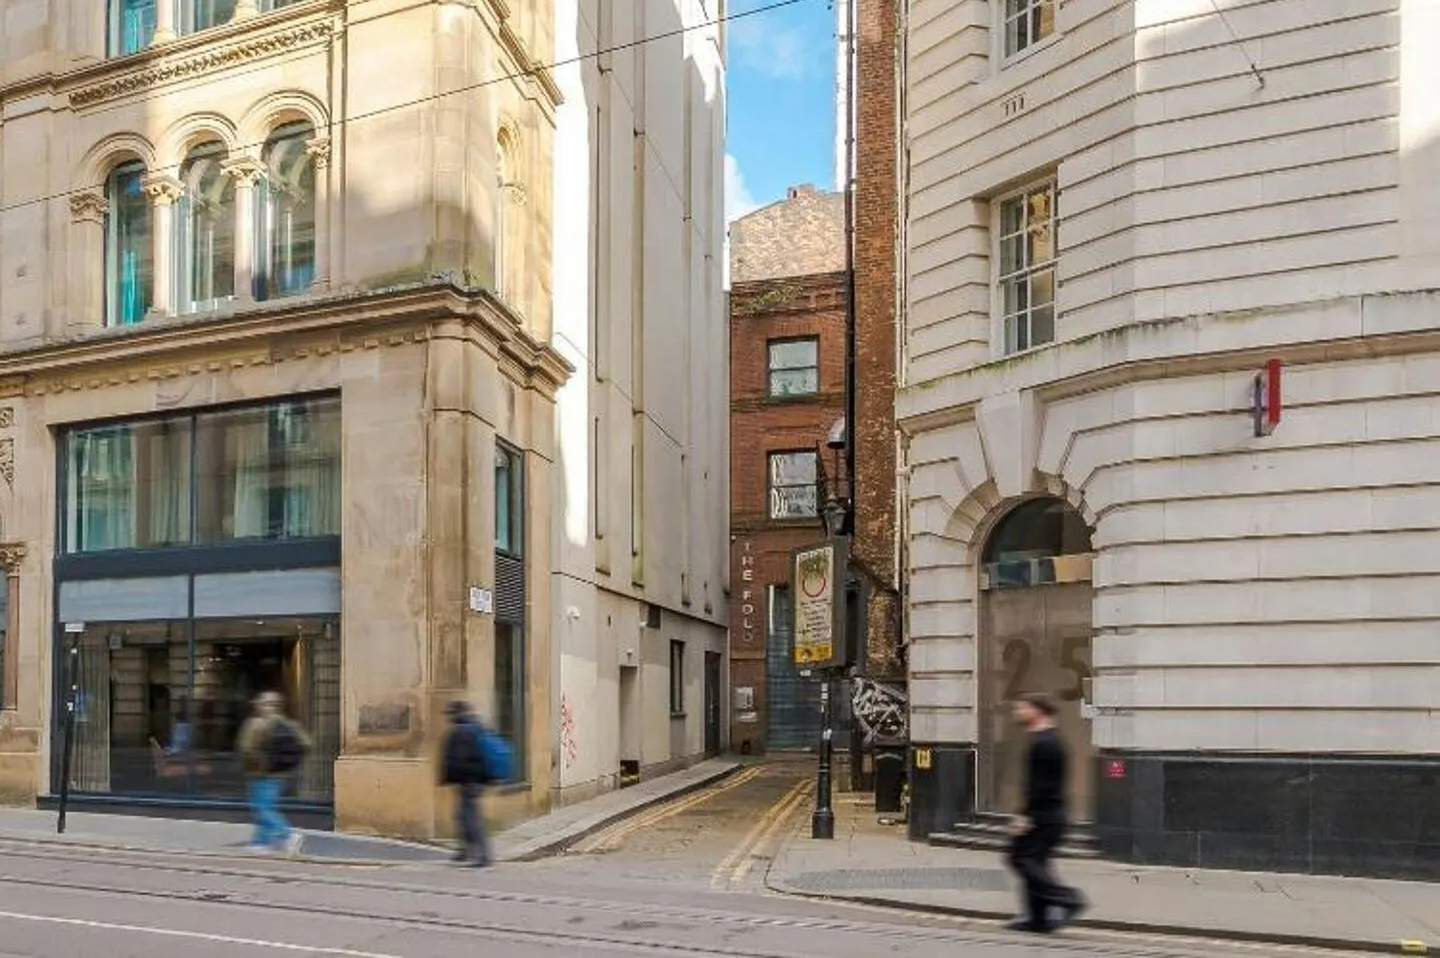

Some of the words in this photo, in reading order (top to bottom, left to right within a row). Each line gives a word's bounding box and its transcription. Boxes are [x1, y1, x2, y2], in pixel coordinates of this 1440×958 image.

[742, 542, 754, 582] THE
[742, 590, 754, 642] FOLD
[1002, 636, 1092, 701] 25
